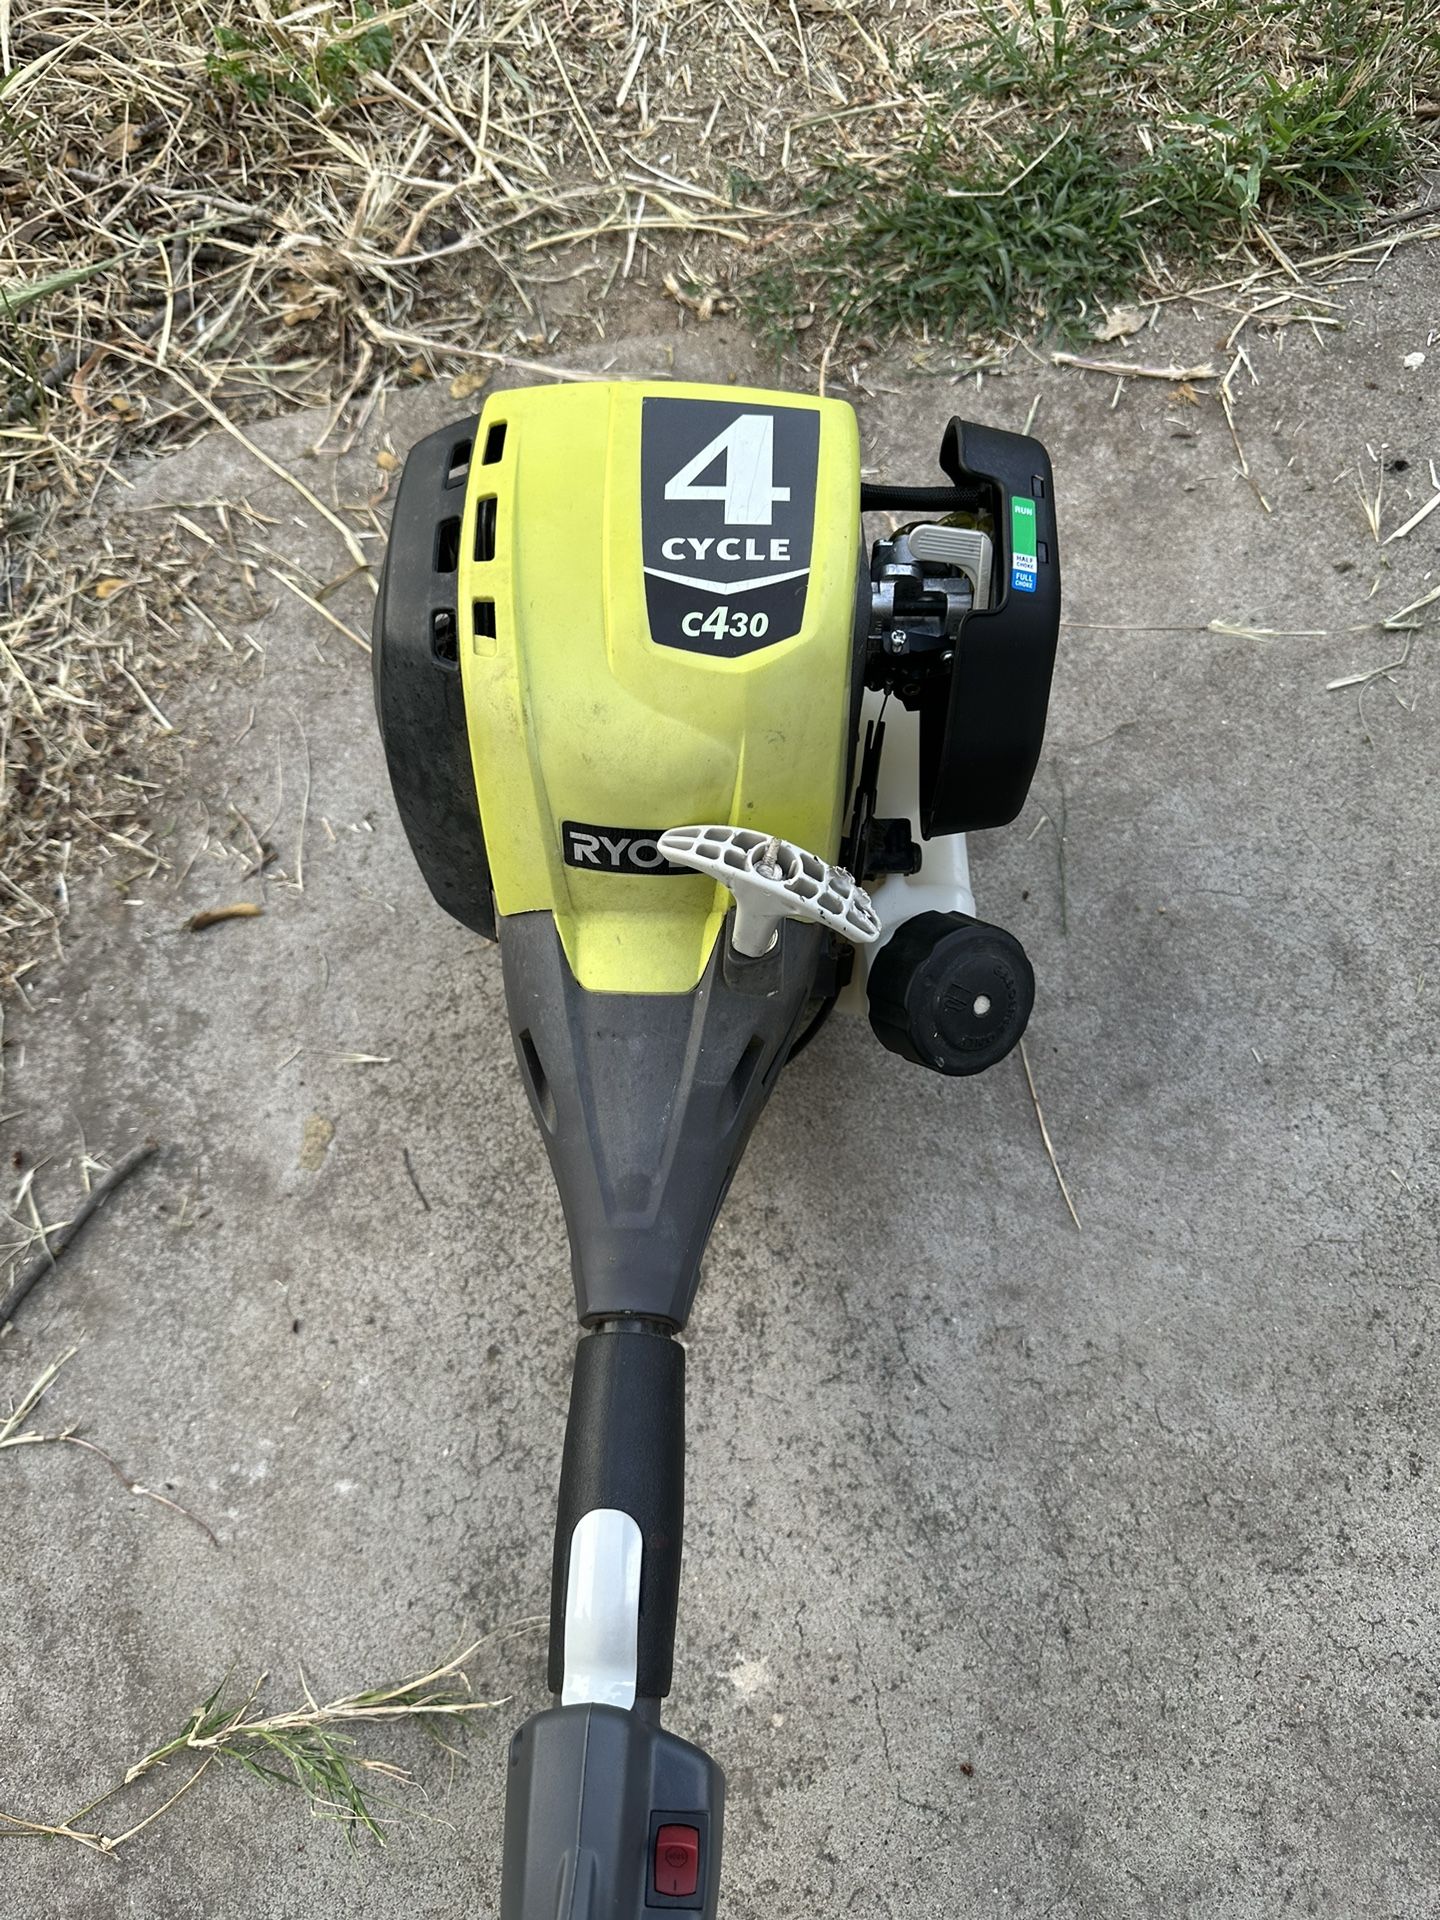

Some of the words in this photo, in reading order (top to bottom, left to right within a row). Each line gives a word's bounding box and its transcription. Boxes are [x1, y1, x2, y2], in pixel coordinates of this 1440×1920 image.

[664, 414, 791, 525] 4
[1014, 505, 1033, 516] RUN
[661, 537, 791, 561] CYCLE
[1016, 555, 1033, 563] HALF
[1016, 561, 1034, 570] CHOKE
[1015, 572, 1033, 582] FULL
[1015, 580, 1033, 589] CHOKE
[681, 606, 769, 640] C430
[569, 831, 688, 868] RYO
